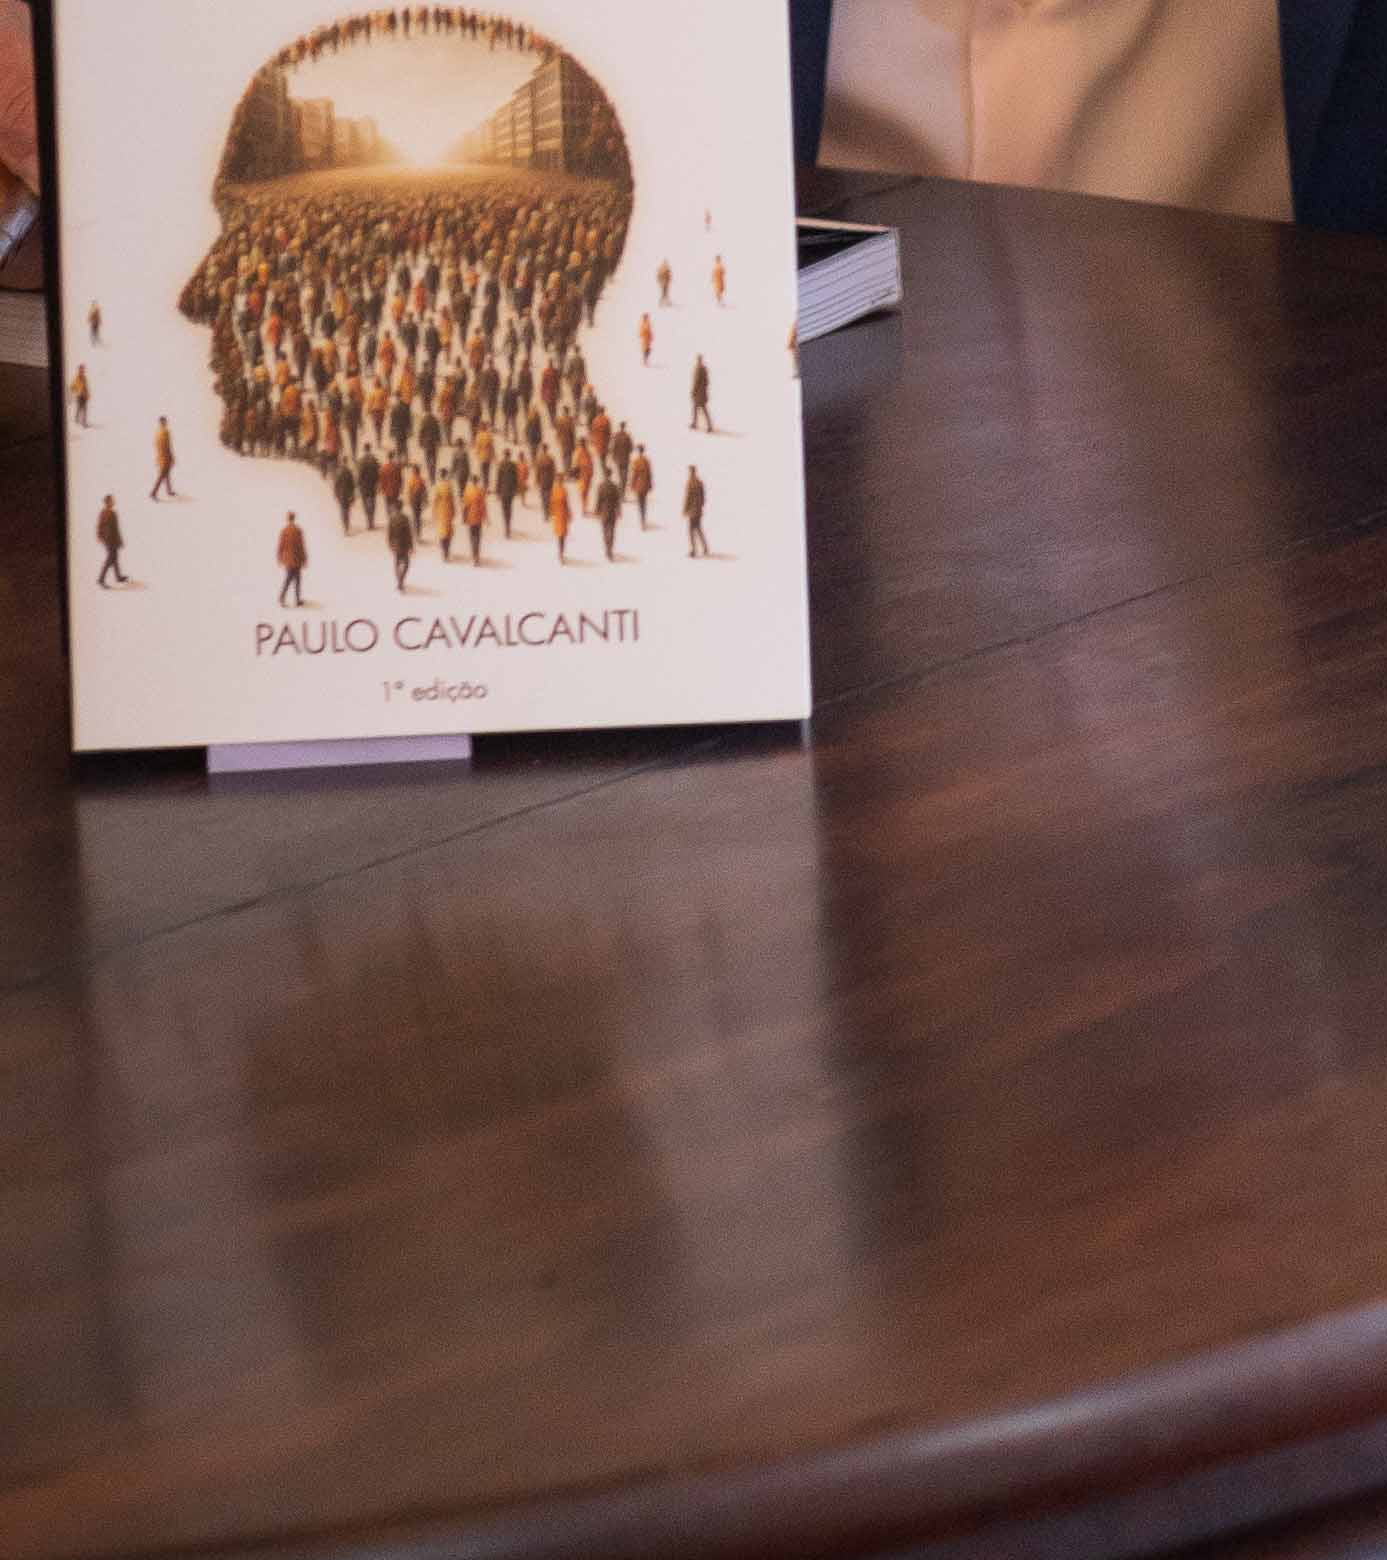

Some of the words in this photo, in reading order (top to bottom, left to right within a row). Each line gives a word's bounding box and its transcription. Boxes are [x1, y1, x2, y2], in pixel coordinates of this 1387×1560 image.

[255, 618, 379, 657] PAULO
[394, 608, 640, 652] CAVALCANTI
[411, 677, 488, 703] edição
